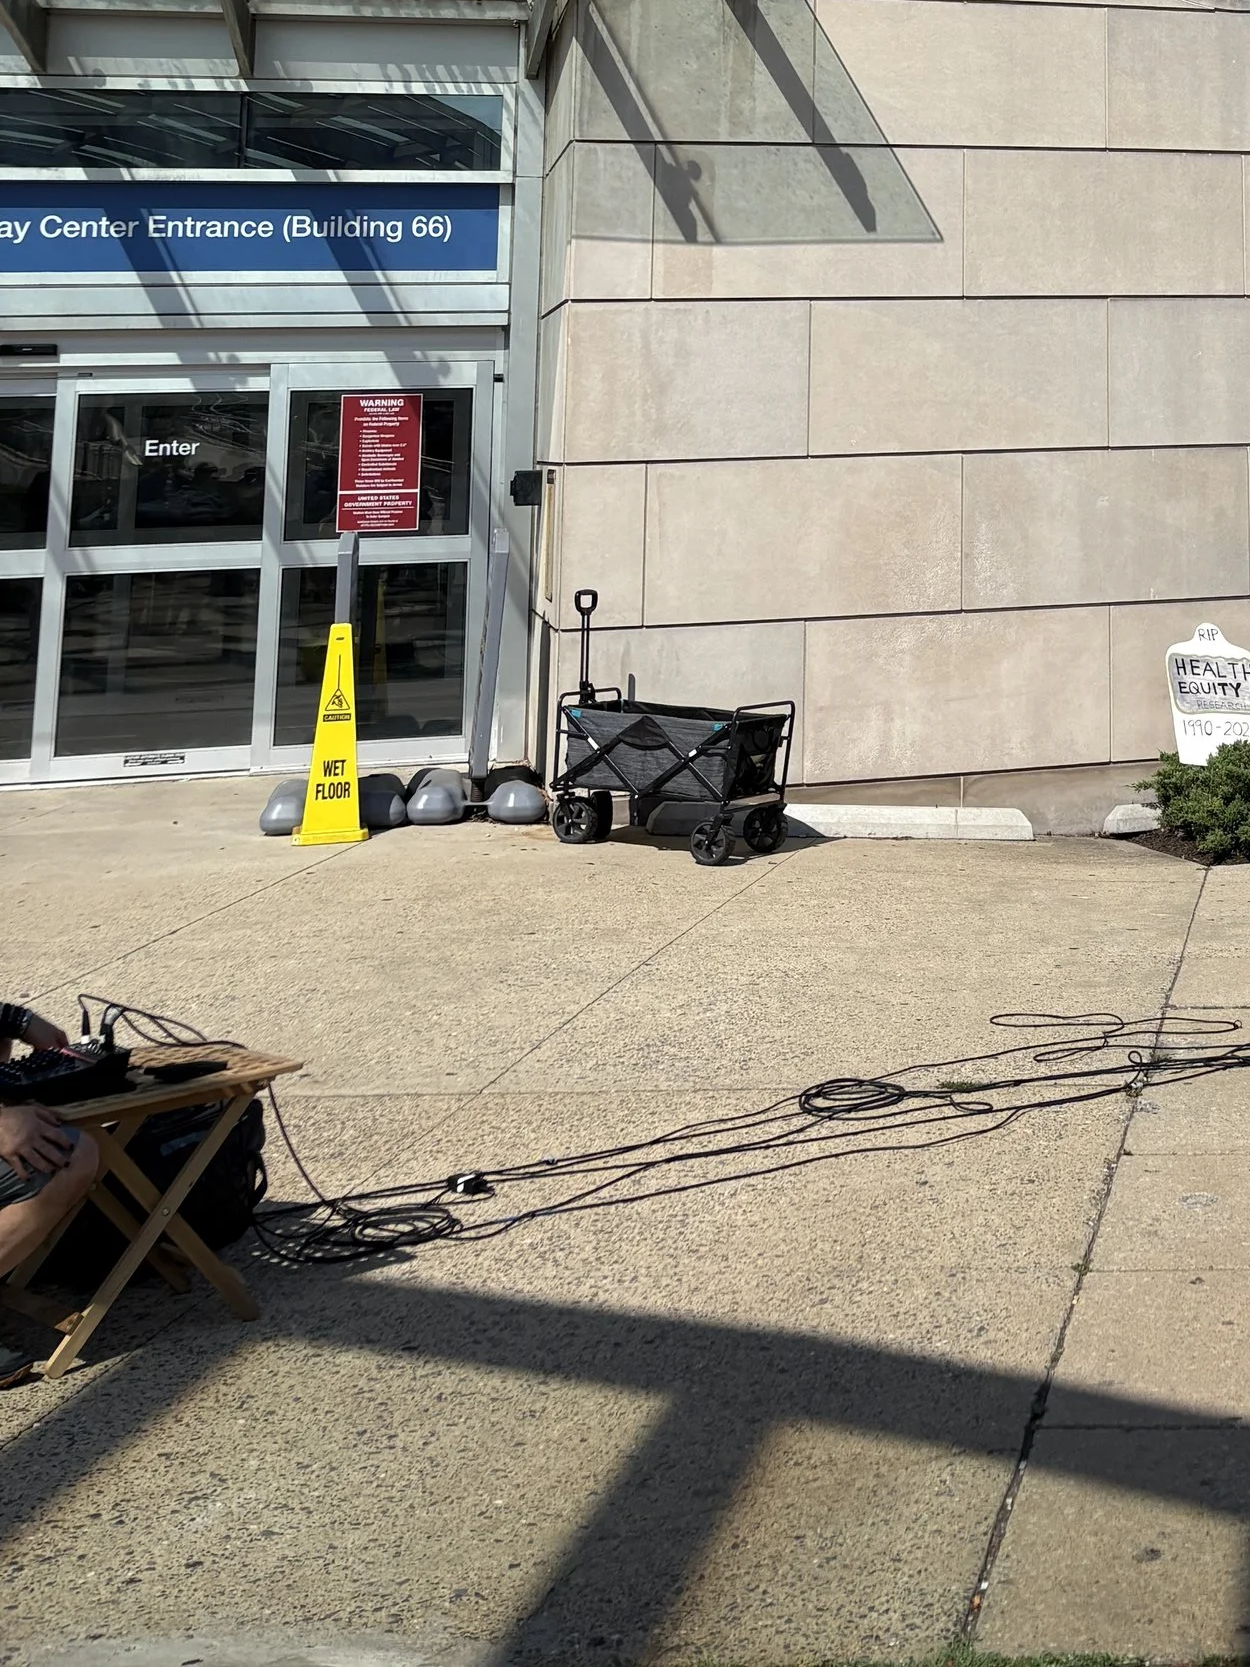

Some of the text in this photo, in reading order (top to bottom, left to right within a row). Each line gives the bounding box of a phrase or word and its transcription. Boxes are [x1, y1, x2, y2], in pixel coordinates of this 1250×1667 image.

[39, 214, 139, 239] Center
[148, 214, 274, 239] Entrance
[282, 214, 403, 244] (Building
[411, 214, 453, 243] 66)
[359, 399, 404, 407] WARNING
[144, 440, 200, 457] Enter
[1197, 628, 1219, 641] RIP
[1178, 681, 1242, 698] EQUITY
[1196, 699, 1248, 710] RESEARCH
[324, 714, 351, 722] CAUTION
[323, 759, 346, 777] WET
[315, 781, 350, 801] FLOOR
